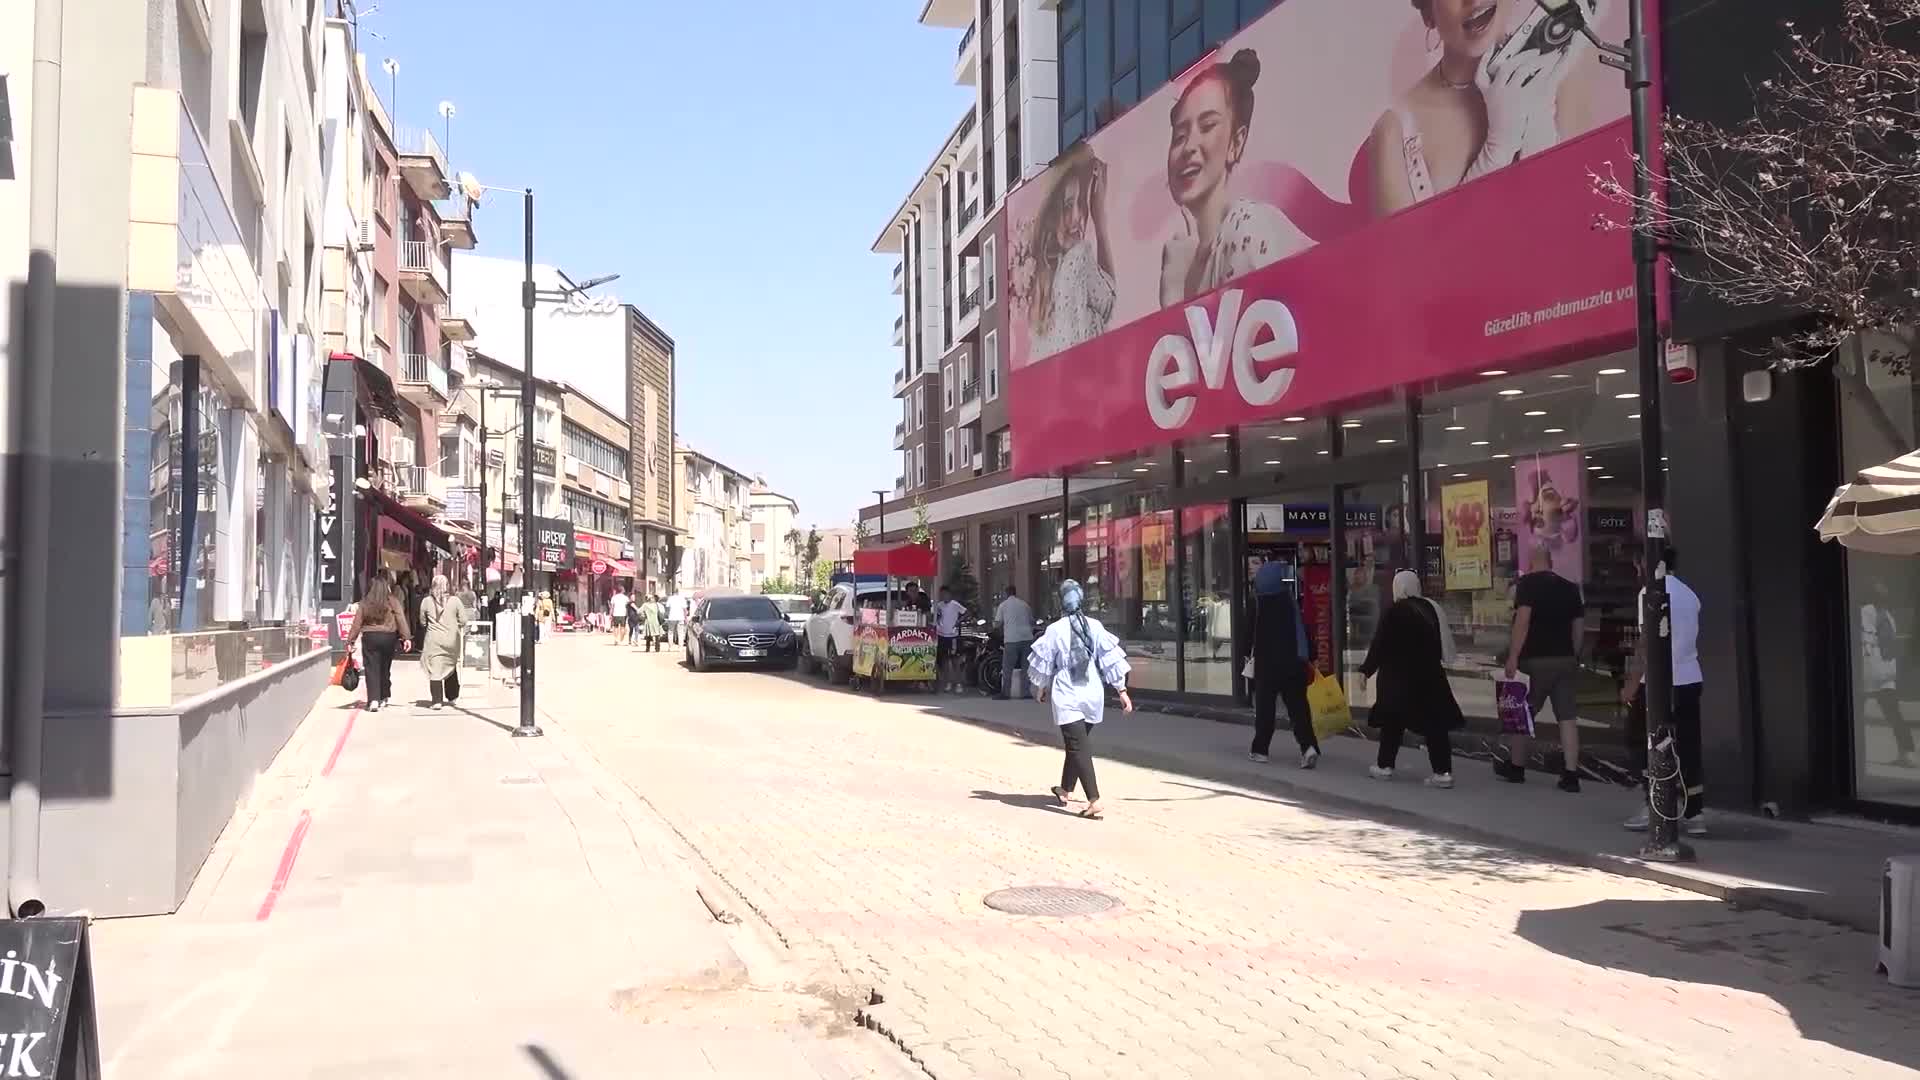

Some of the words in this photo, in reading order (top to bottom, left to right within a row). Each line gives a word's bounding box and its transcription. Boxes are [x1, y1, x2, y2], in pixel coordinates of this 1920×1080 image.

[1485, 311, 1532, 336] Güzellik
[1534, 290, 1613, 323] modumuzda
[1616, 285, 1638, 301] va
[1145, 288, 1298, 430] eve
[1288, 511, 1377, 521] MAYBLINE
